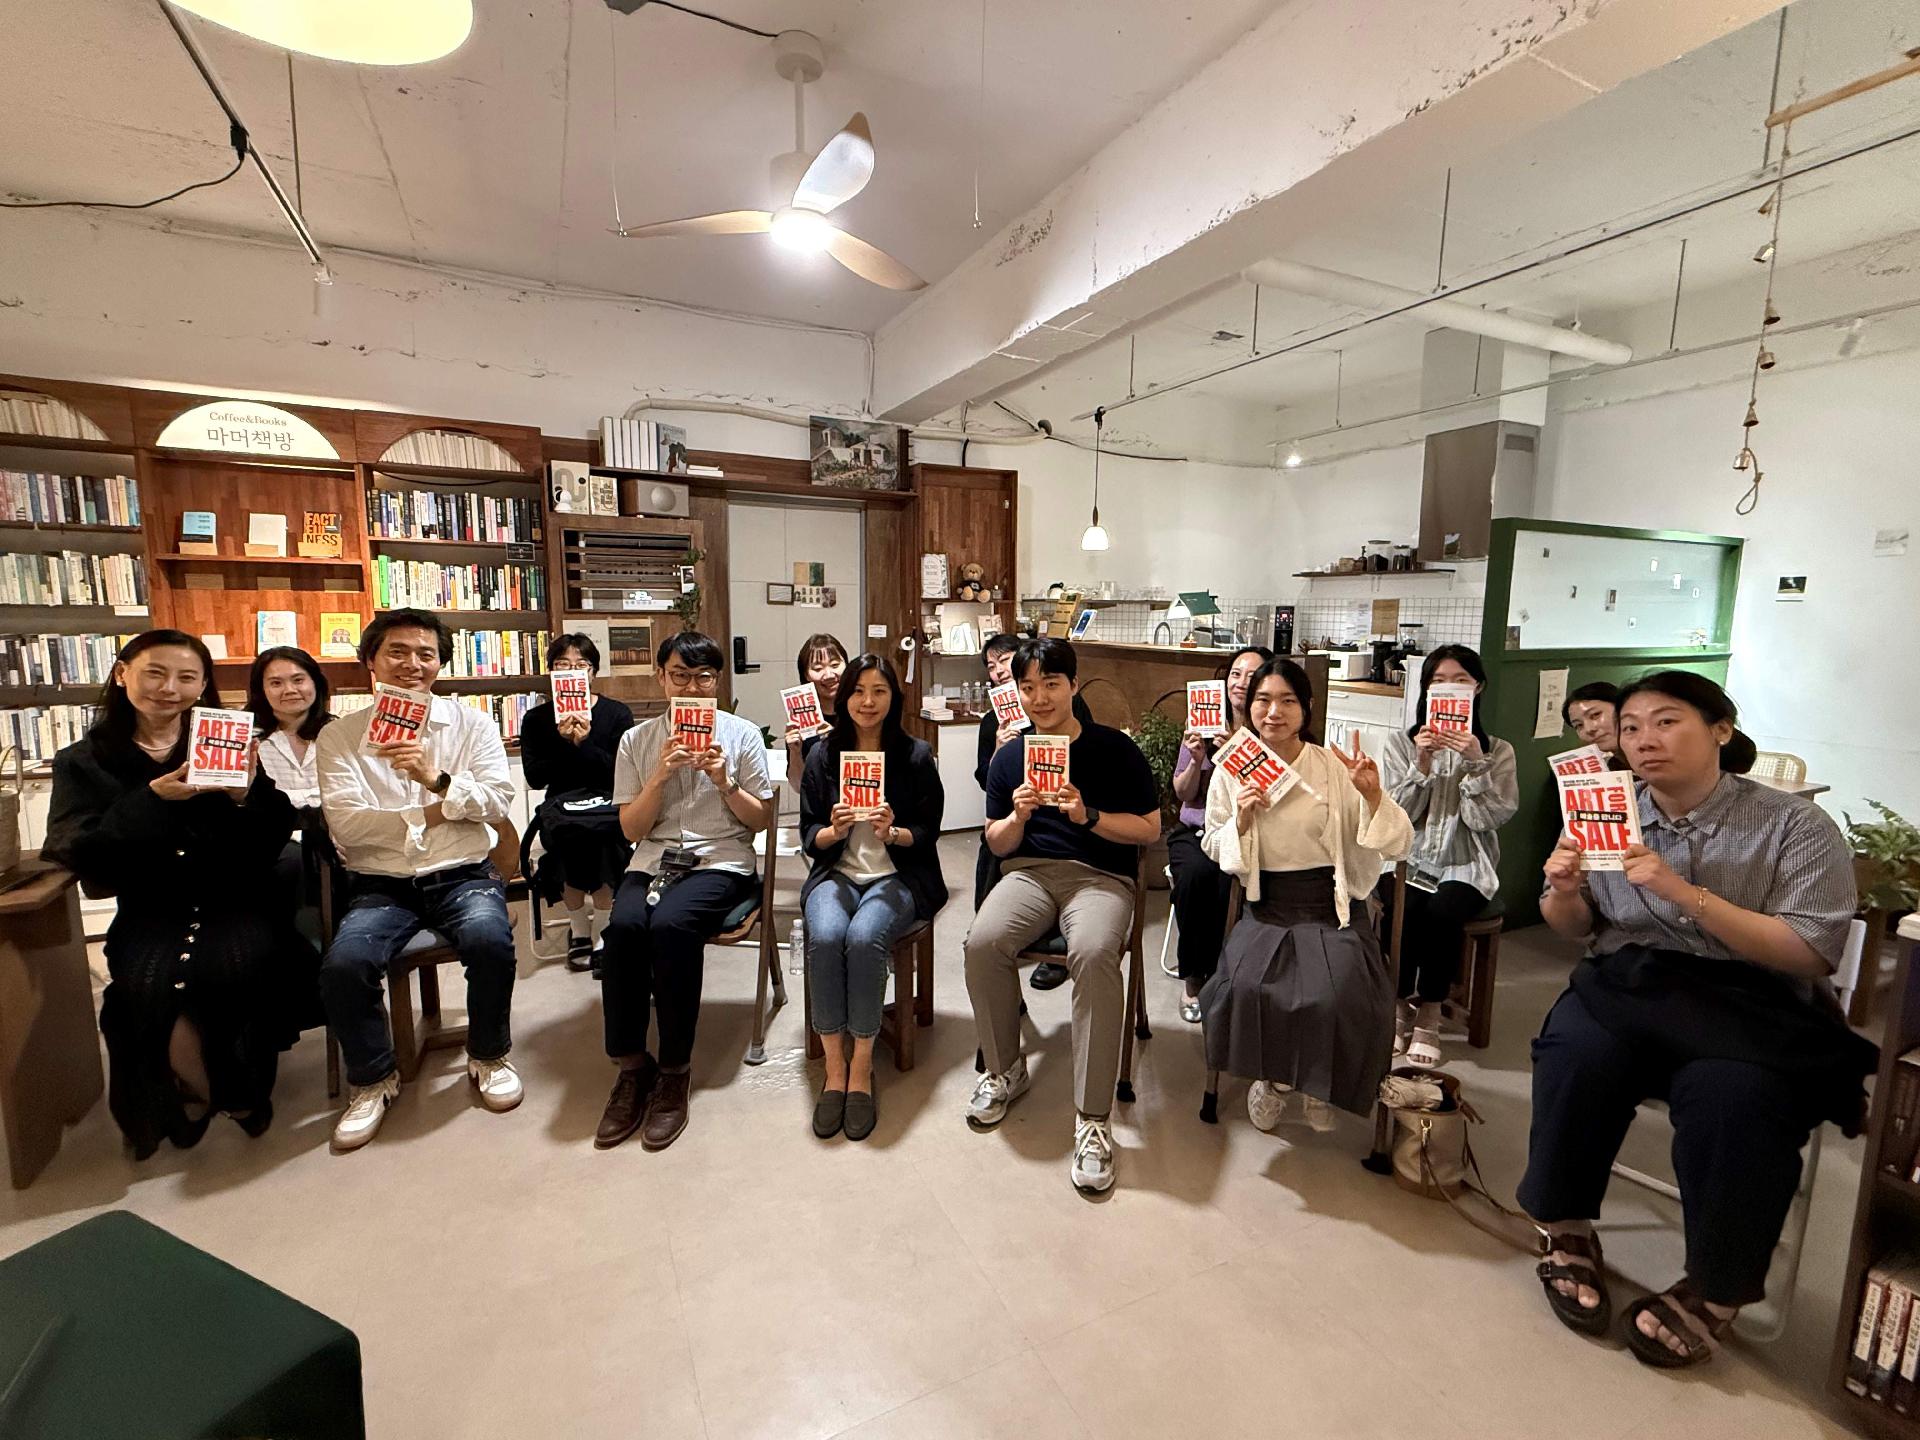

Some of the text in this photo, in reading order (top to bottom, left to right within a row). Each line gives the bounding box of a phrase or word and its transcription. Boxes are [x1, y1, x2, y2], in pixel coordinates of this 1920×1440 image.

[210, 411, 288, 427] Coffee&Books
[207, 427, 294, 451] 마머책방
[304, 512, 336, 526] FACT
[555, 679, 576, 692] ART
[577, 678, 587, 692] FOR
[556, 696, 588, 713] SALE
[786, 694, 805, 711] ART
[993, 692, 1009, 706] ART
[1190, 690, 1211, 704] ART
[1212, 689, 1222, 704] FOR
[378, 695, 413, 719] ART
[411, 703, 427, 722] FOR
[1430, 699, 1457, 714] ART
[1459, 699, 1470, 715] FOR
[674, 708, 702, 725] ART
[703, 709, 713, 726] FOR
[790, 711, 821, 728] SALE
[1191, 709, 1222, 726] SALE
[197, 719, 235, 740] ART
[235, 722, 250, 742] FOR
[1242, 737, 1262, 756] FOR
[194, 744, 248, 771] SALE
[1028, 747, 1055, 765] ART
[1056, 748, 1066, 766] FOR
[1223, 746, 1252, 779] ART
[843, 762, 870, 780] ART
[871, 763, 881, 780] FOR
[1556, 759, 1587, 776] ART
[843, 784, 881, 807] SALE
[1565, 788, 1605, 814] ART
[1607, 786, 1628, 812] FOR
[1568, 820, 1630, 852] SALE
